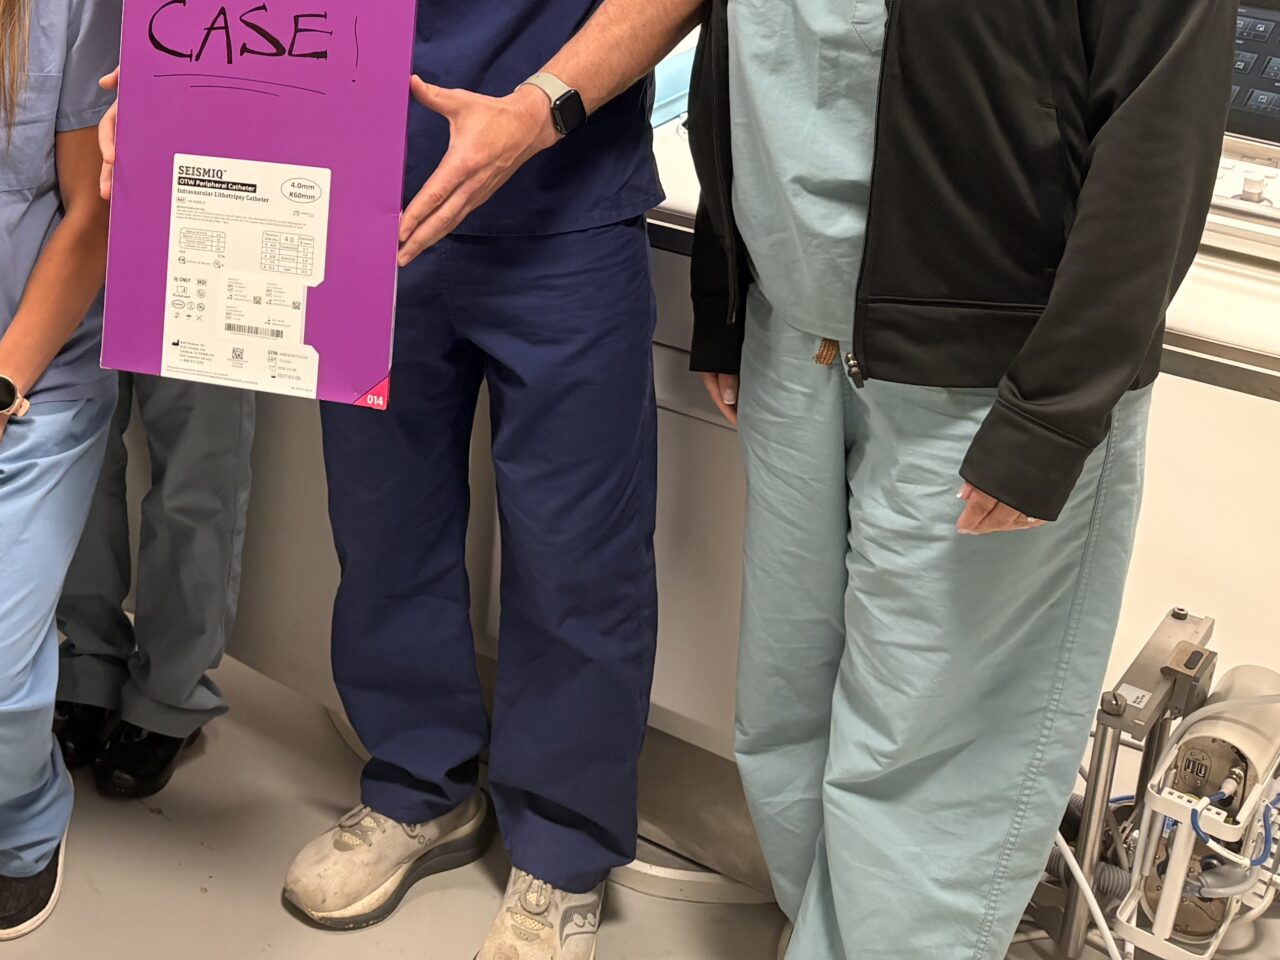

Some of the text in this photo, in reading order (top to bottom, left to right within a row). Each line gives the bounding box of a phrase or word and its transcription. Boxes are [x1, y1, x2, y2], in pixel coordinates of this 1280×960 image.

[179, 178, 256, 192] OTW Peripheral Catheter
[290, 182, 315, 191] 4.0mm
[177, 187, 269, 203] Intravascular Lithotripsy Catheter
[288, 191, 316, 200] X60mm
[366, 394, 384, 406] 014
